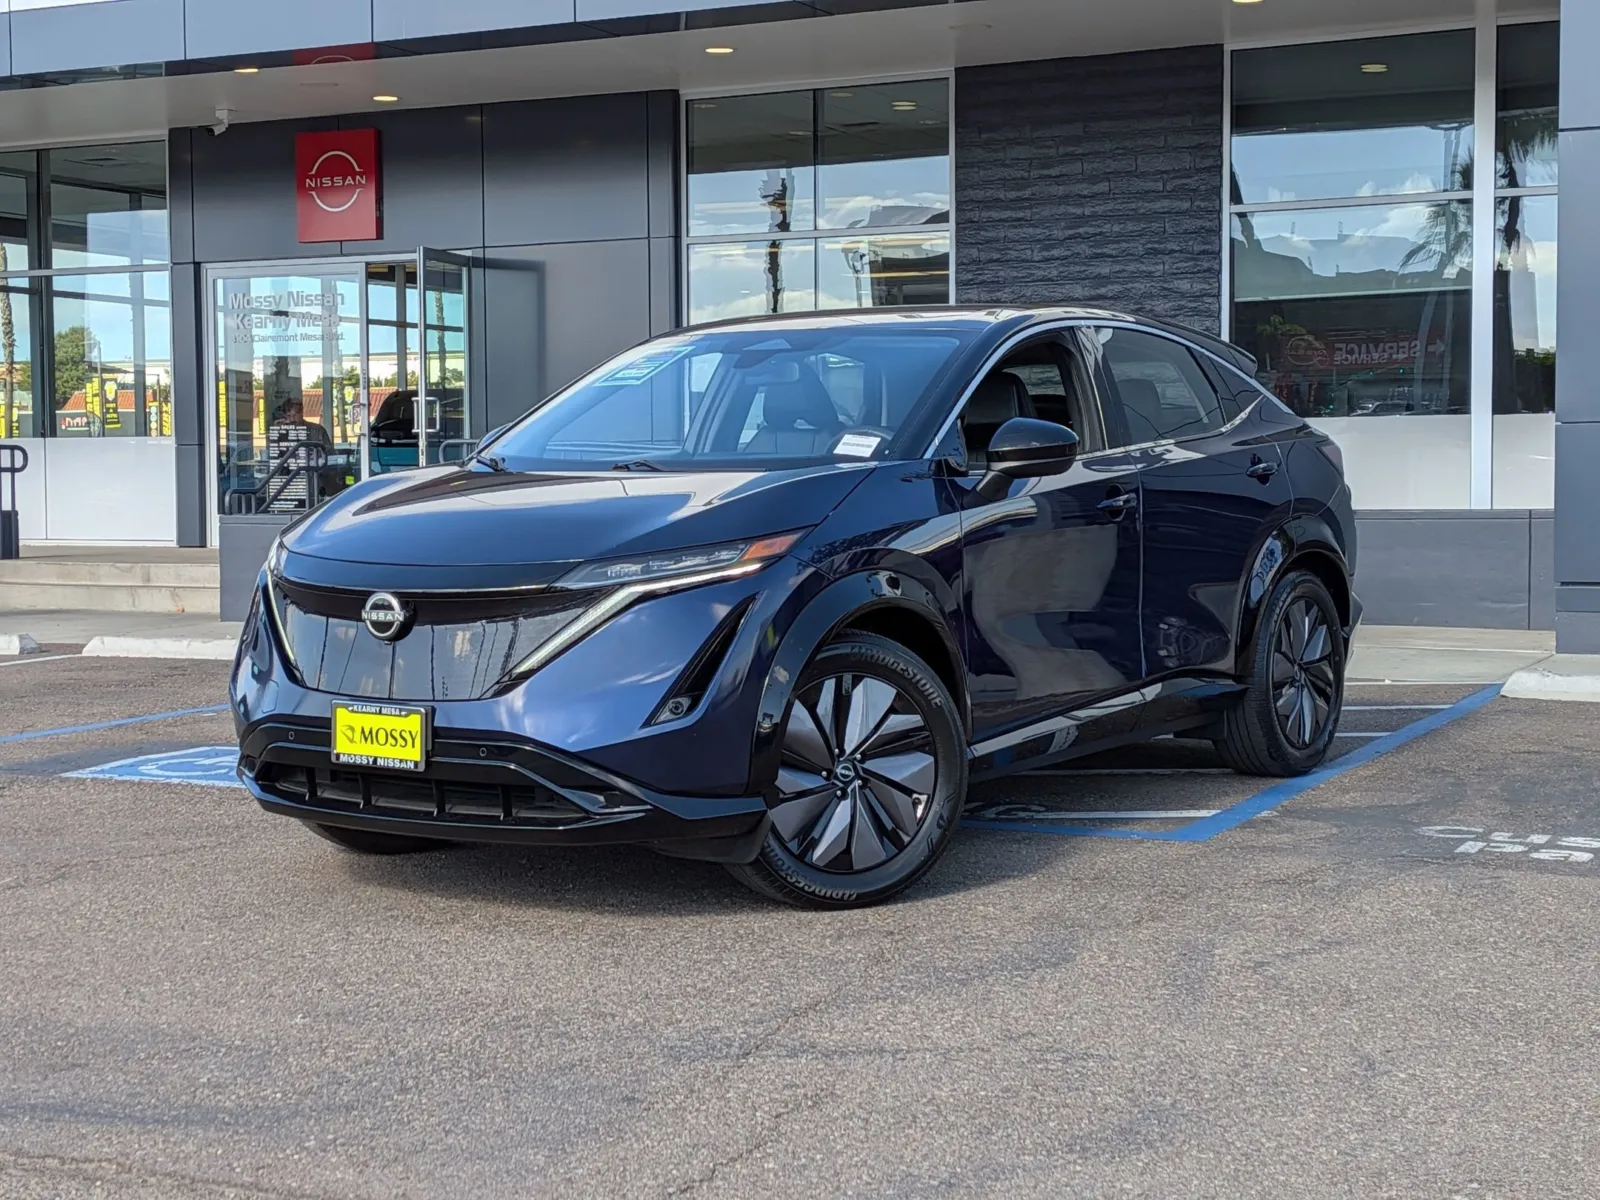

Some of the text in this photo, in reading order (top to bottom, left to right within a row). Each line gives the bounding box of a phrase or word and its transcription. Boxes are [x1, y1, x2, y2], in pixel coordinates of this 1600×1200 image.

[306, 175, 366, 188] NISSAN
[229, 291, 345, 310] Mossy Nissan
[234, 312, 341, 331] Kearny Mesa
[252, 333, 298, 343] Clairemont
[300, 333, 325, 342] Mesa
[361, 610, 405, 622] NISSAN
[353, 705, 400, 715] KEARNY MESA
[360, 725, 419, 749] MOSSY
[339, 753, 415, 769] MOSSY NISSAN
